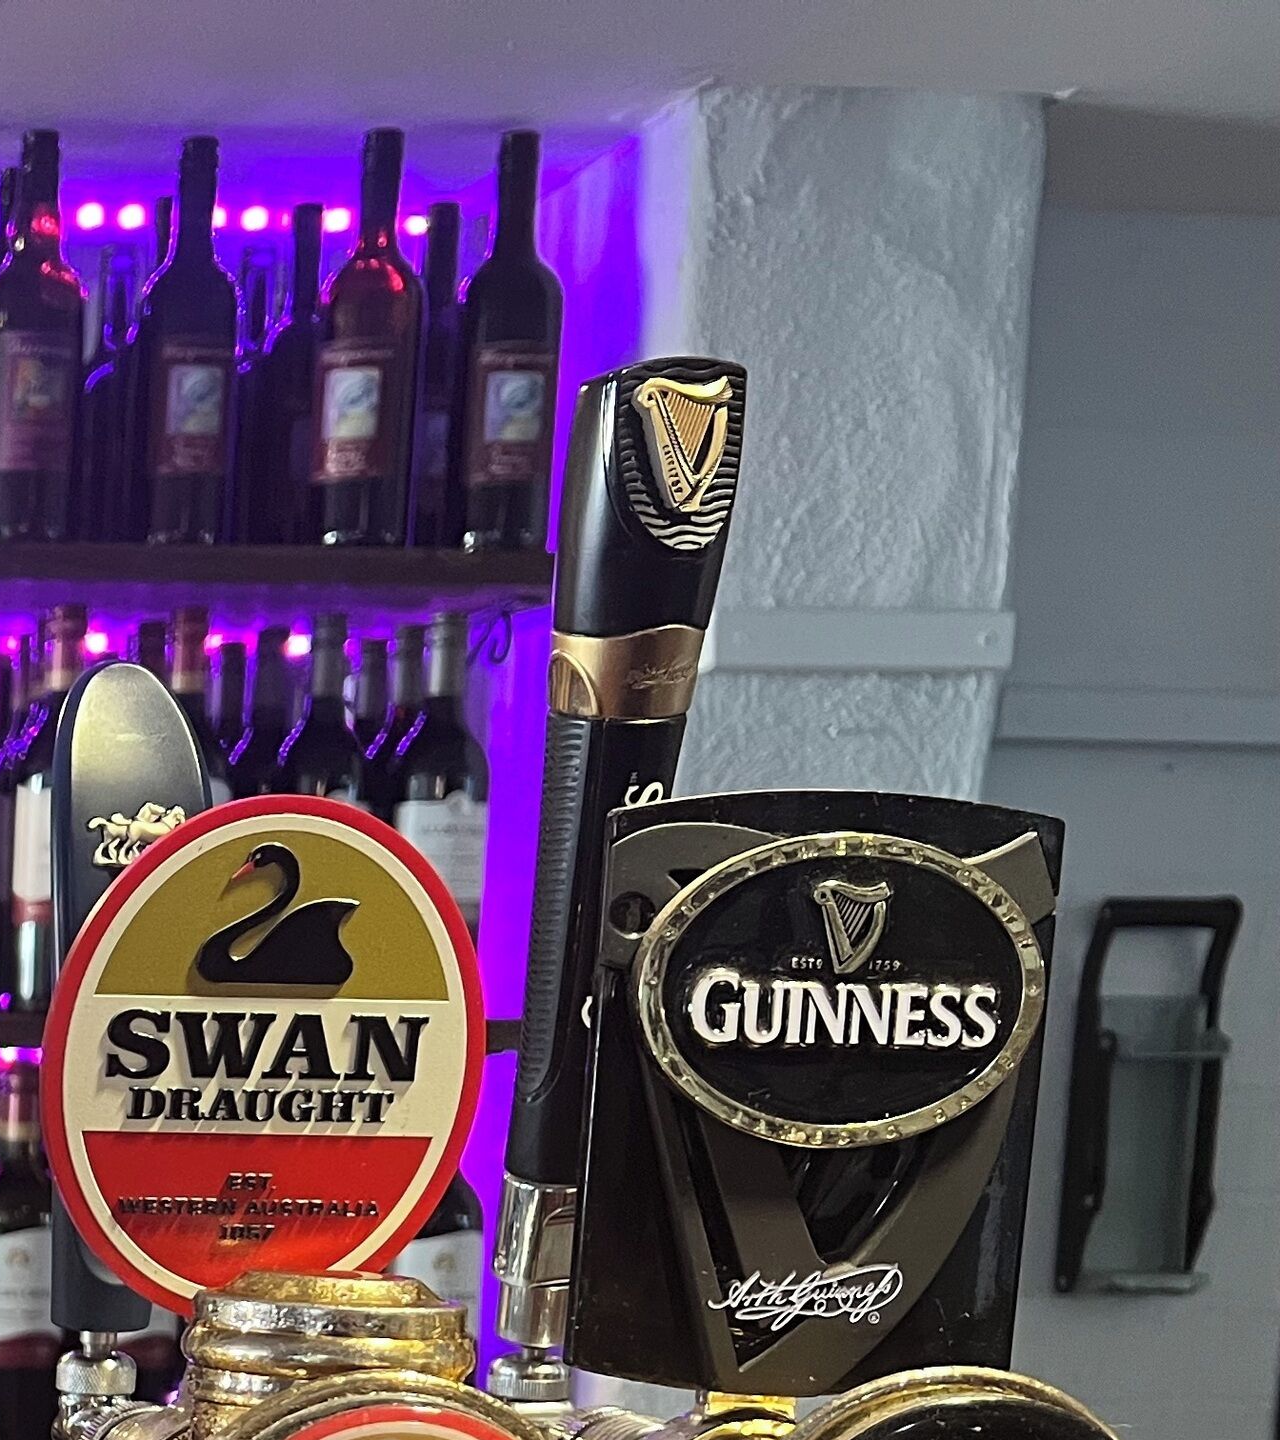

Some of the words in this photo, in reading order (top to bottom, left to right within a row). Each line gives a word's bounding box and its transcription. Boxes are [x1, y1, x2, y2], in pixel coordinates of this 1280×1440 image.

[868, 959, 901, 971] 1759
[104, 1008, 430, 1084] SWAN
[126, 1086, 395, 1125] DRAUGHT
[117, 1195, 238, 1216] WESTERN
[242, 1197, 380, 1217] AUSTRALIA
